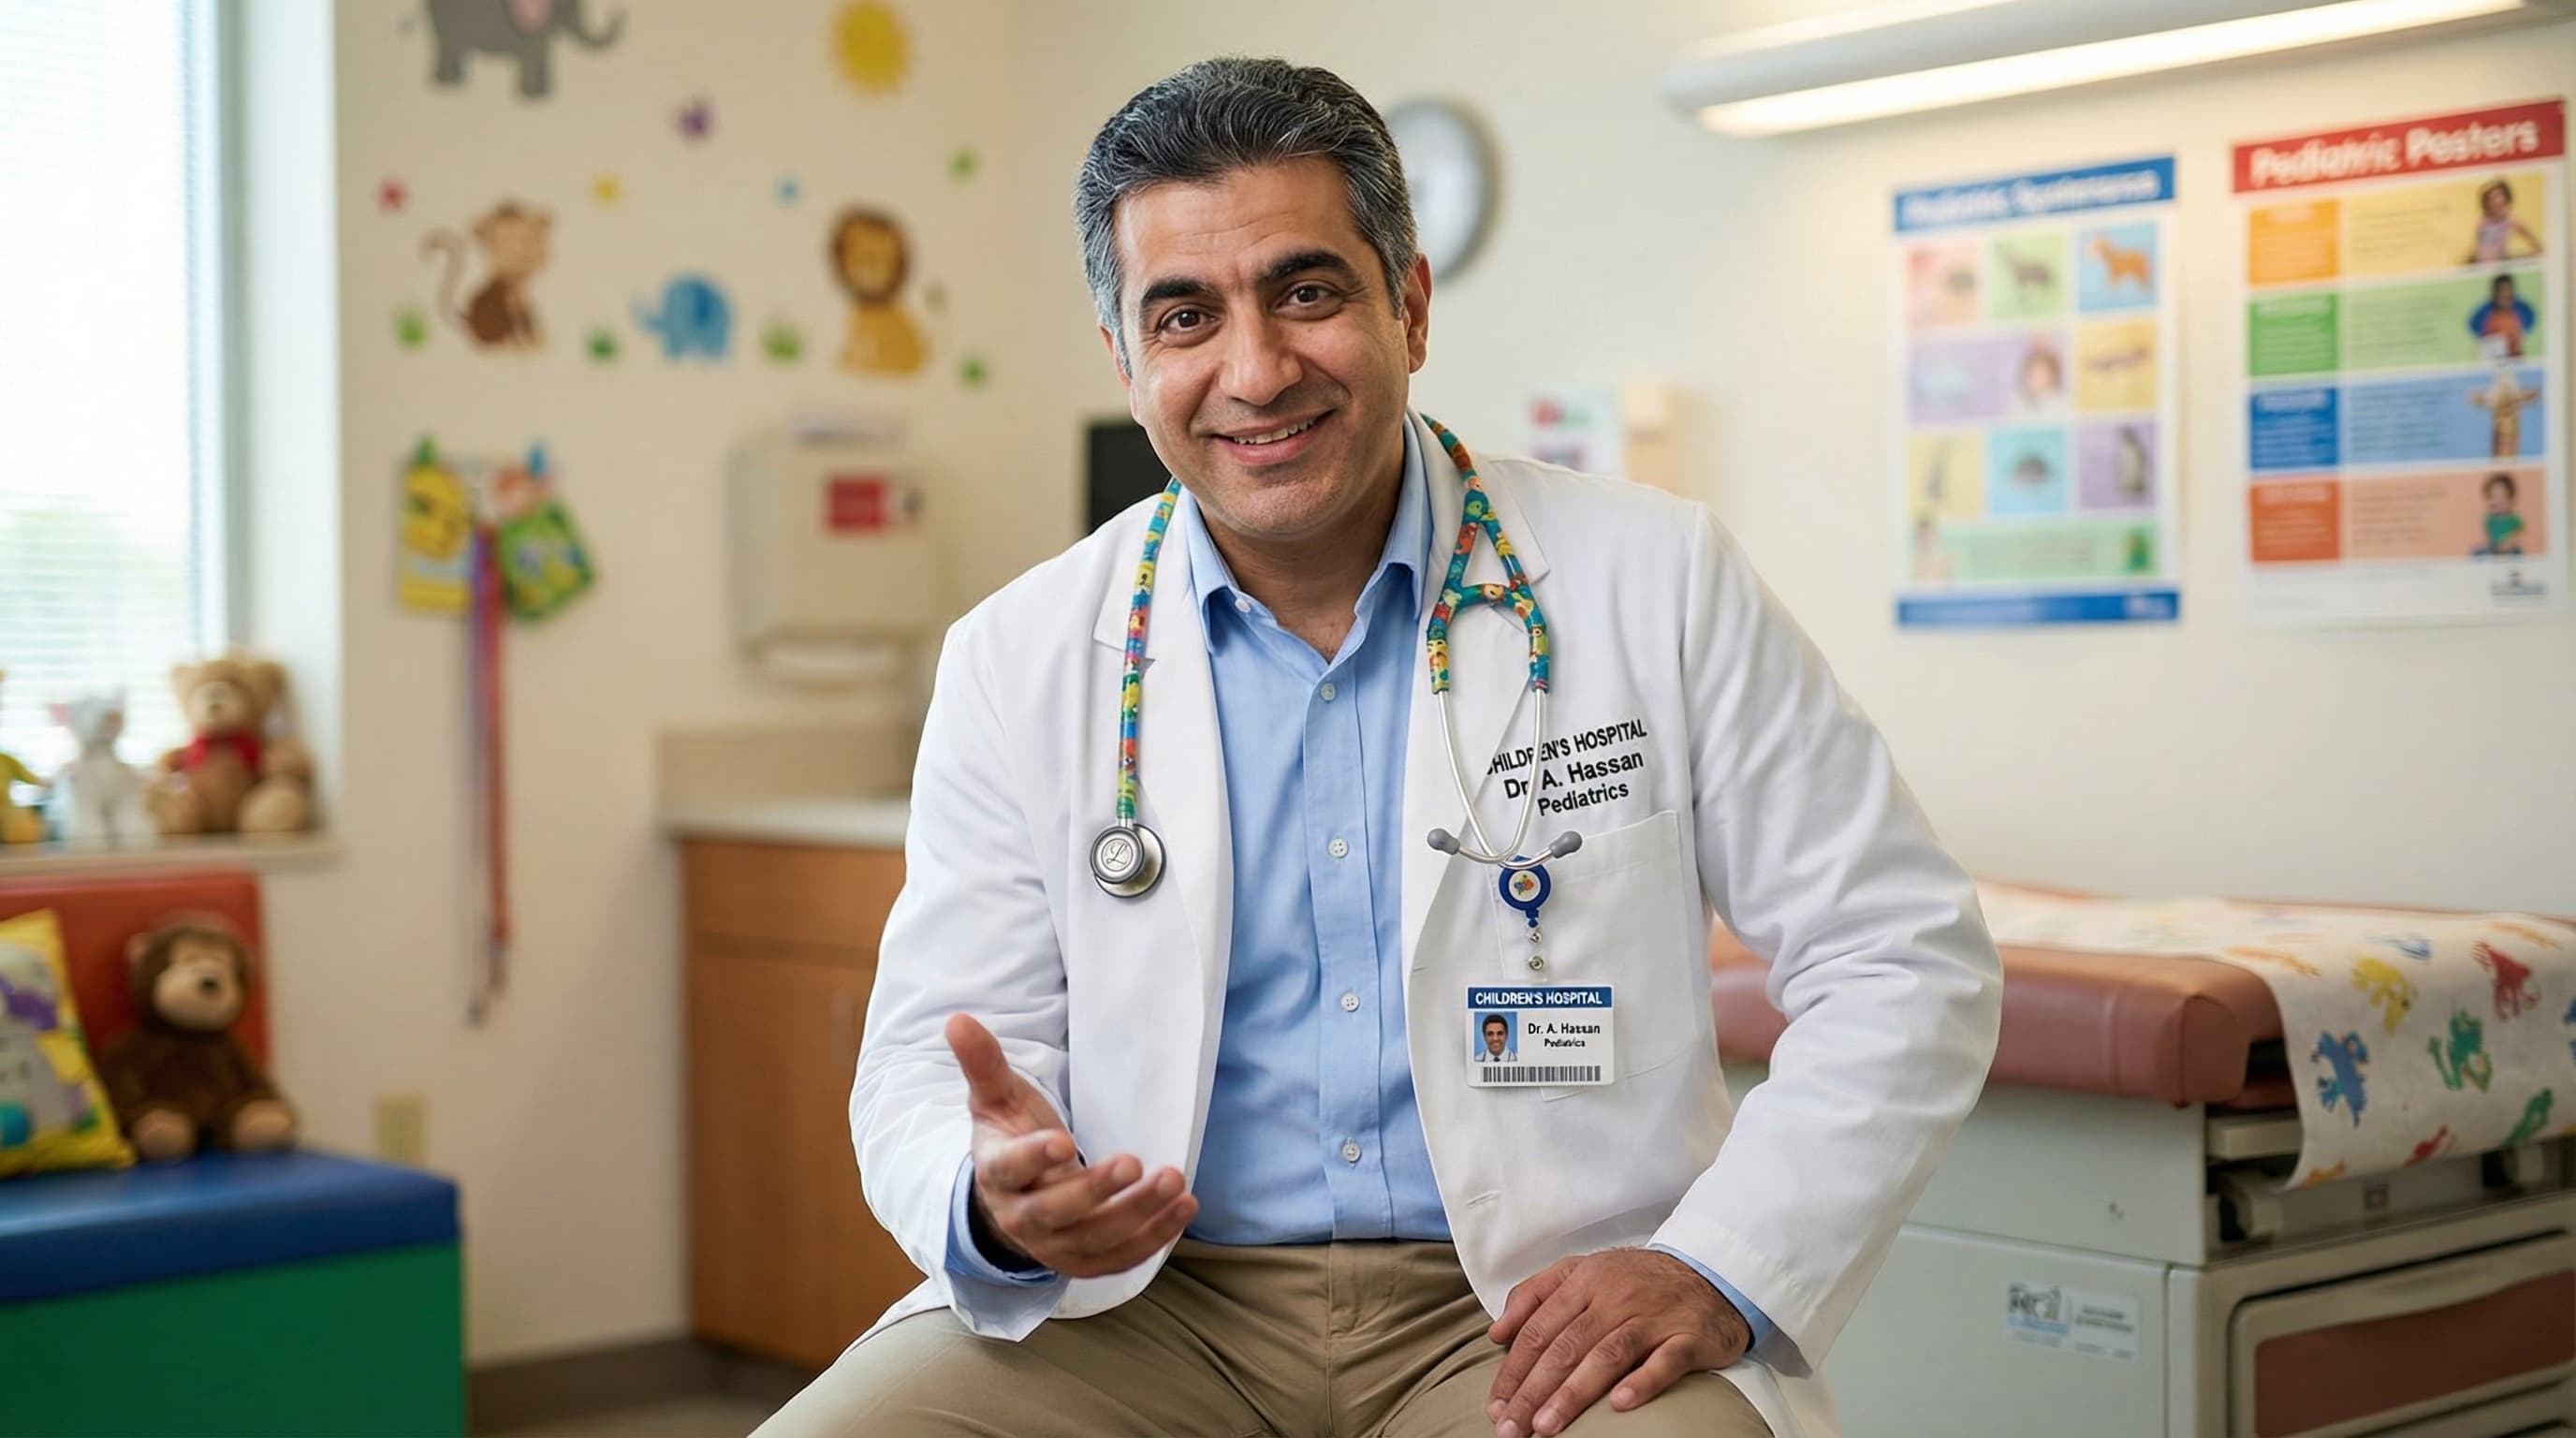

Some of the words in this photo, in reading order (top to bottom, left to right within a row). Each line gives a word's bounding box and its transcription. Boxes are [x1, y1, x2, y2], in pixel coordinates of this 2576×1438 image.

[1486, 738, 1571, 775] HILDREN'S
[1573, 719, 1647, 753] HOSPITAL
[1542, 769, 1563, 790] A.
[1567, 752, 1644, 784] Hassan
[1537, 783, 1629, 816] Pediatrics
[1475, 991, 1544, 1005] CHILDREN'S
[1545, 990, 1603, 1005] HOSPITAL
[1528, 1022, 1544, 1034] Dr.
